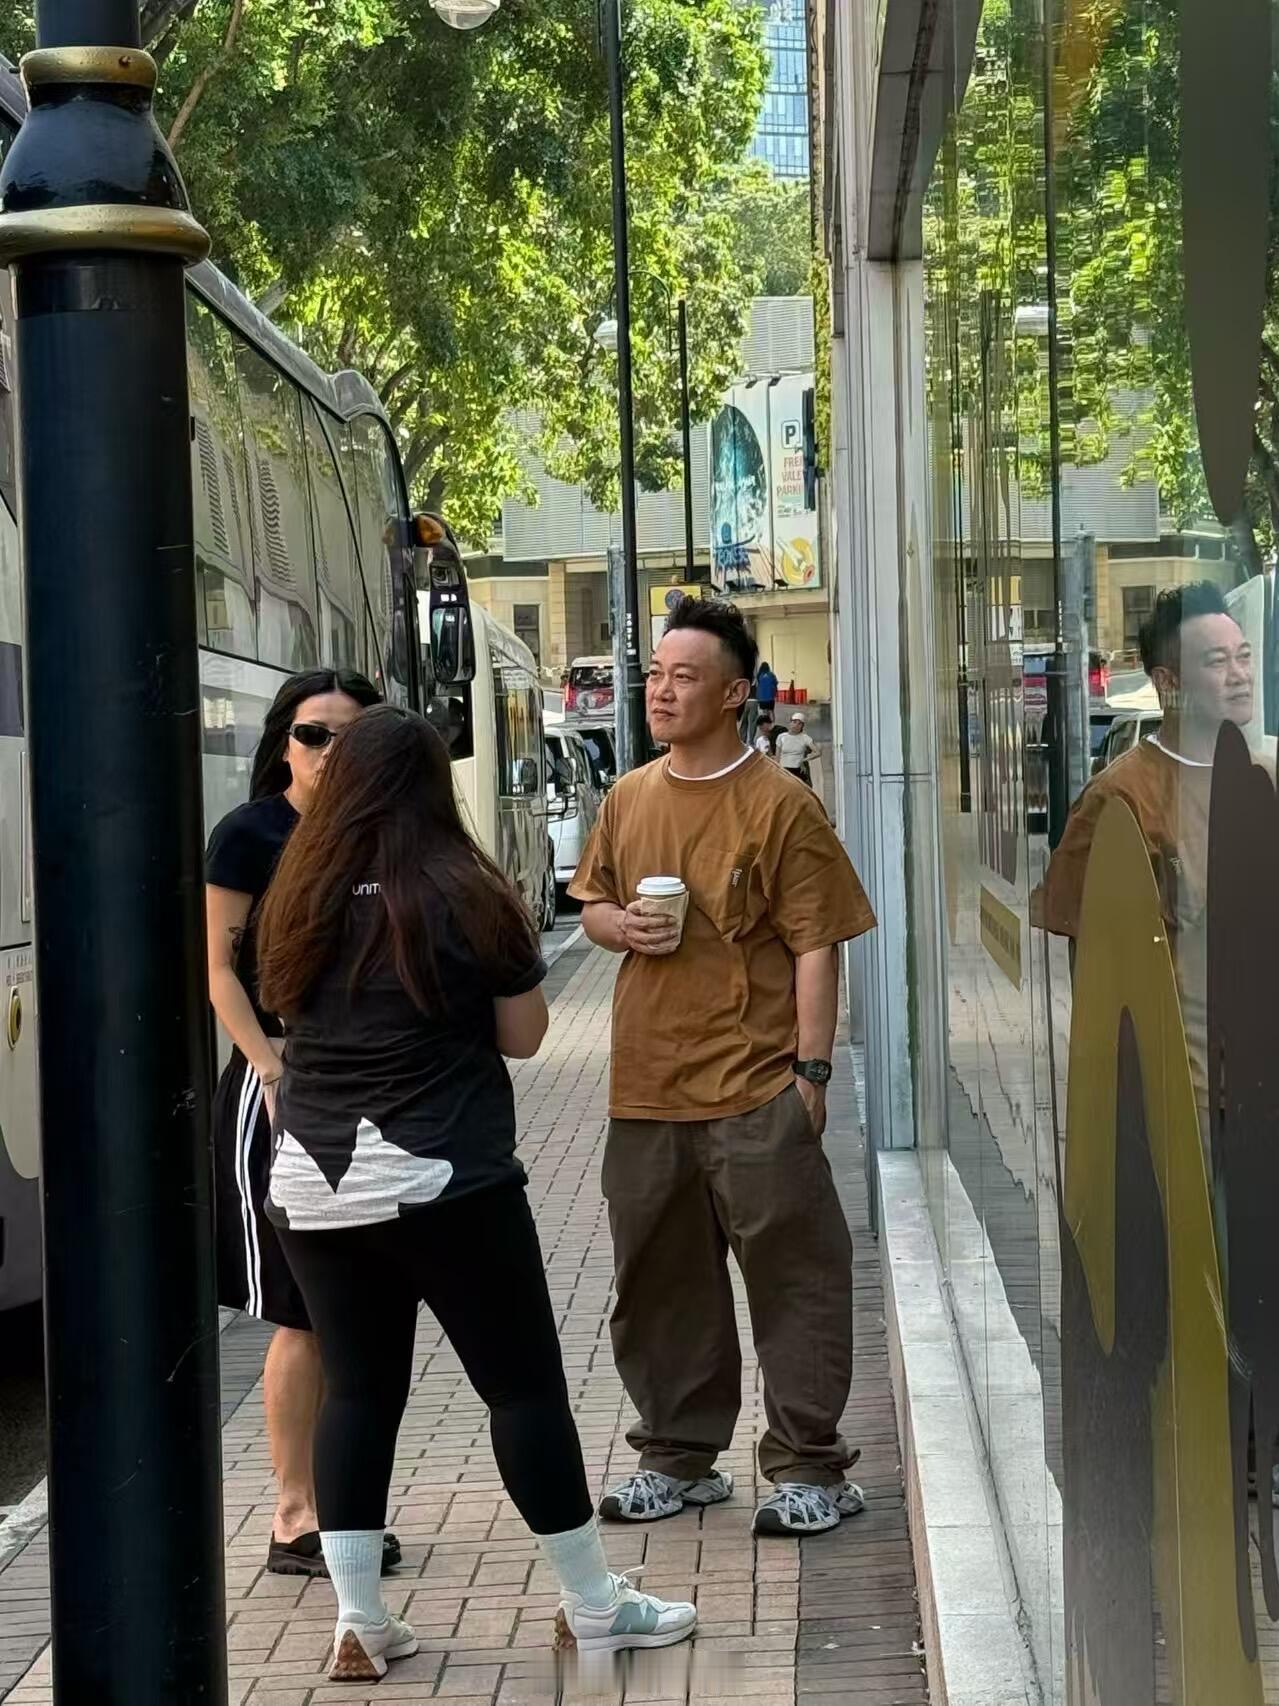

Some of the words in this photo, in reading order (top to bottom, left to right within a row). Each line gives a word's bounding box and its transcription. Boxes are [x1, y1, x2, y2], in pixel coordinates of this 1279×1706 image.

[785, 425, 796, 445] P
[784, 456, 802, 468] FRE
[782, 470, 802, 482] VALE
[776, 485, 801, 497] PARKI
